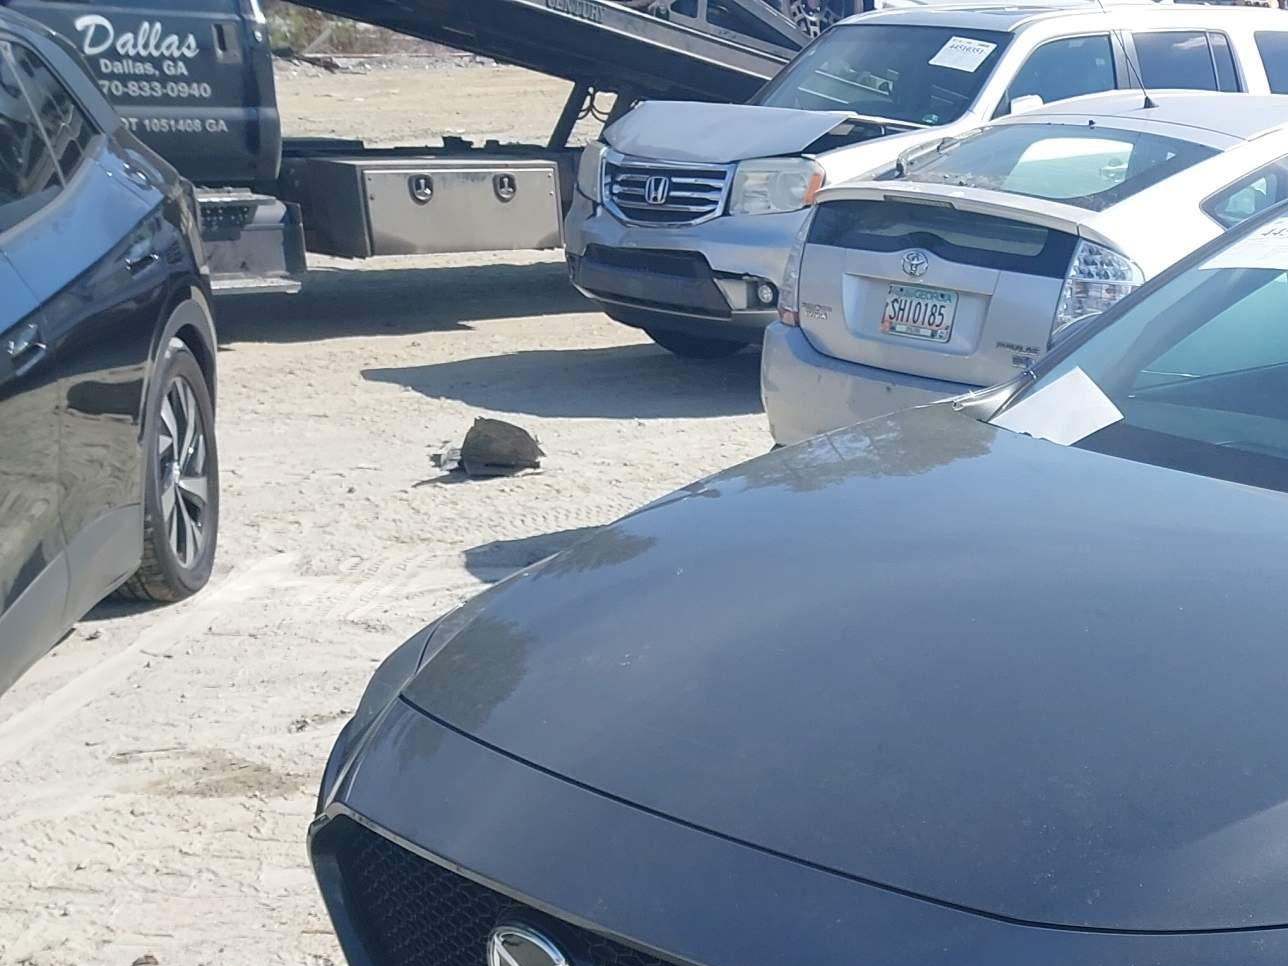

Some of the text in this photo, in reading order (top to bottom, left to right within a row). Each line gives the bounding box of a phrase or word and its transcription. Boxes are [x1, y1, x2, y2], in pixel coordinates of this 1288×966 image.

[75, 14, 199, 58] Dallas
[99, 58, 188, 77] Dallas, GA
[205, 119, 229, 132] GA
[888, 298, 946, 328] SHI0185
